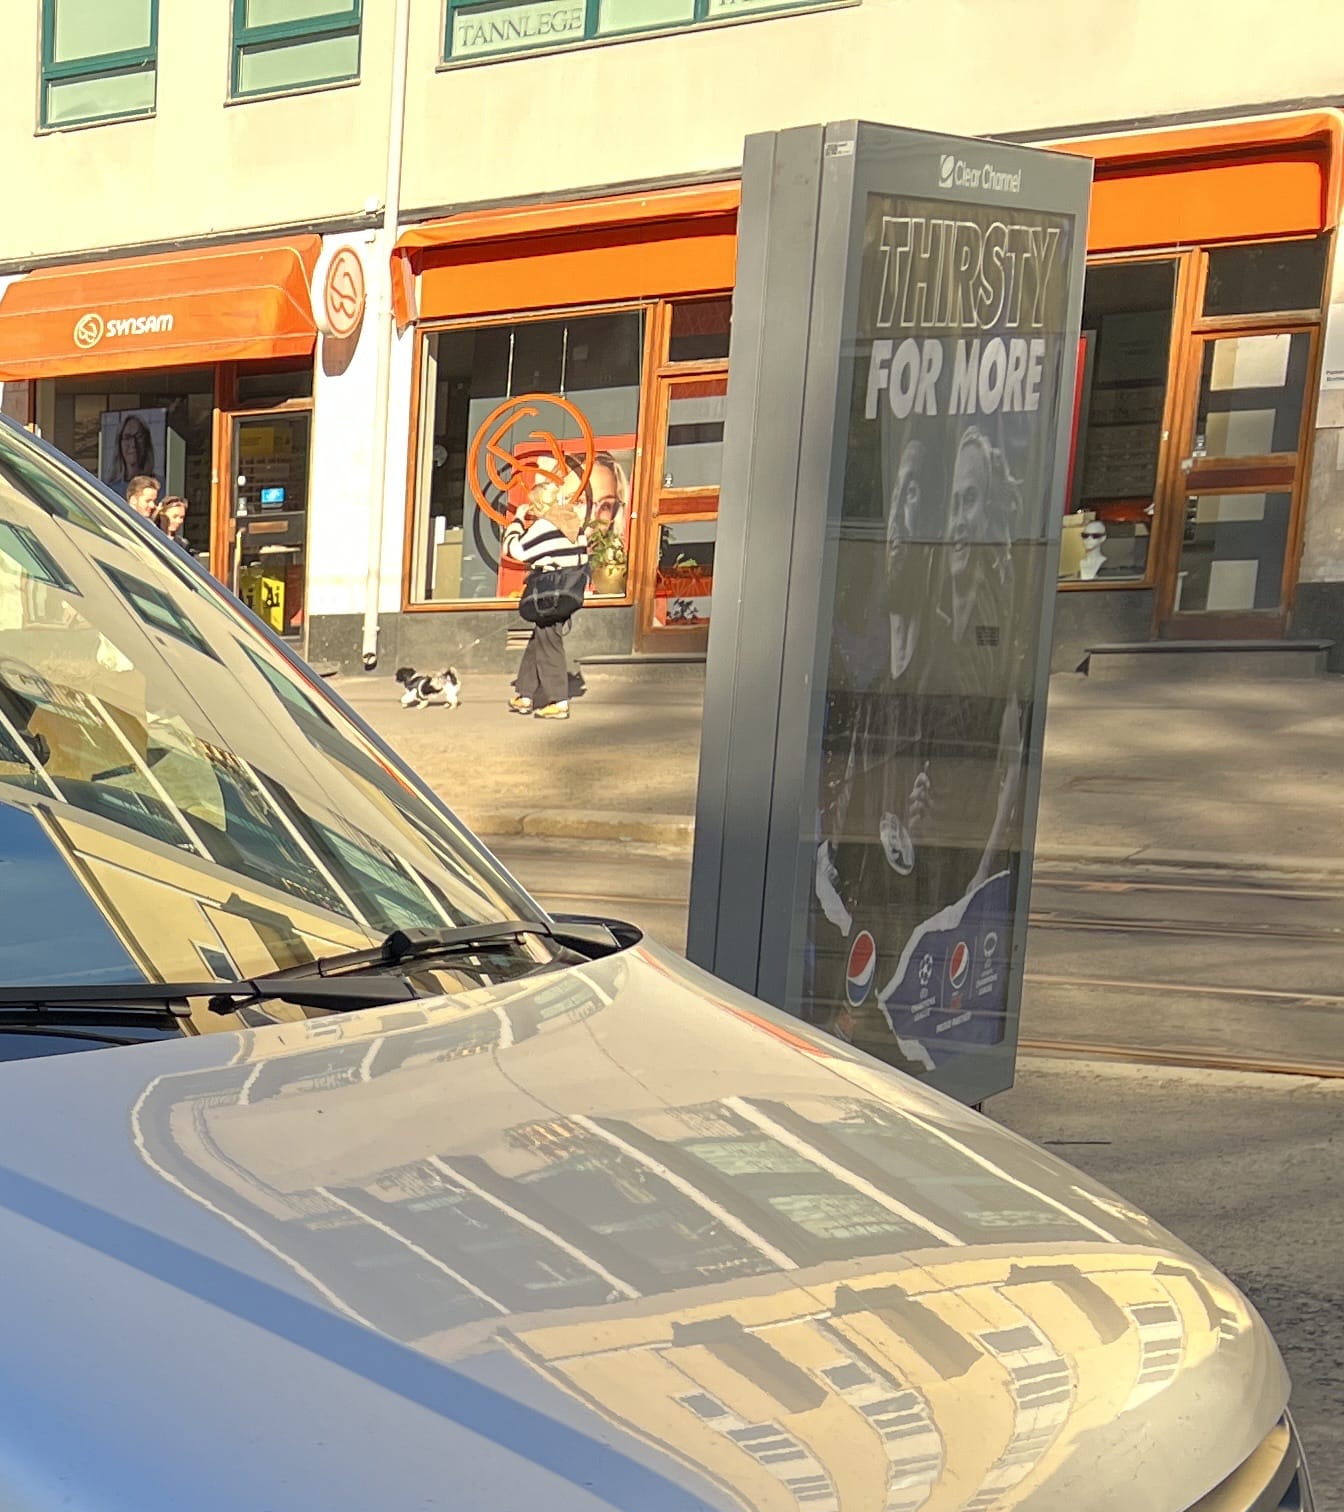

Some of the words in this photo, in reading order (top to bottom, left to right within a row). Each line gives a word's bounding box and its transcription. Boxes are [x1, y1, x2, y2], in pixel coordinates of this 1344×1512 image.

[459, 8, 583, 46] TANNLEGE
[955, 161, 981, 188] Clear
[982, 164, 1022, 193] Channel
[876, 216, 1060, 330] THIRSTY
[865, 337, 944, 420] FOR
[948, 337, 1045, 416] MORE
